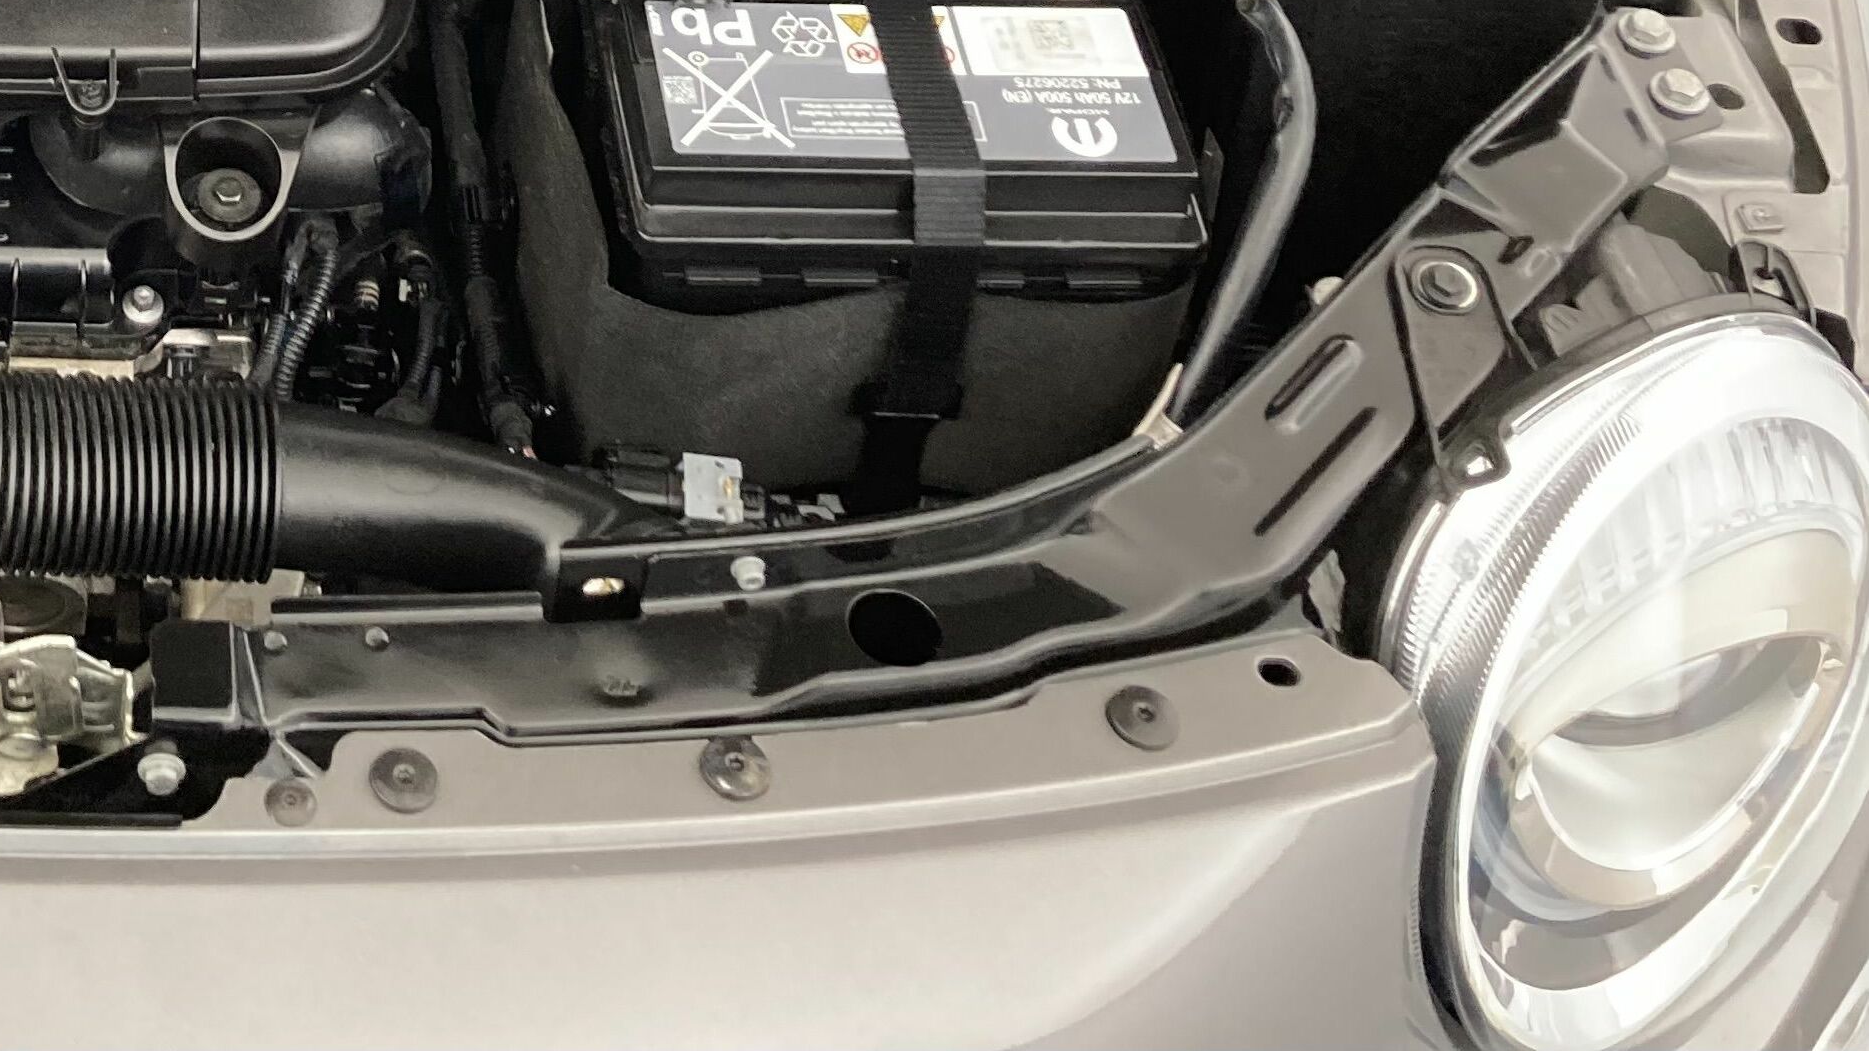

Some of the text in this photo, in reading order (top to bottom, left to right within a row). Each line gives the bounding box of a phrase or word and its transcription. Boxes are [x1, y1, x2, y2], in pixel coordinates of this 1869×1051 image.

[671, 6, 756, 47] Pb
[1034, 91, 1072, 104] 500A
[1074, 91, 1112, 104] 50Ah
[1115, 91, 1142, 104] 12V
